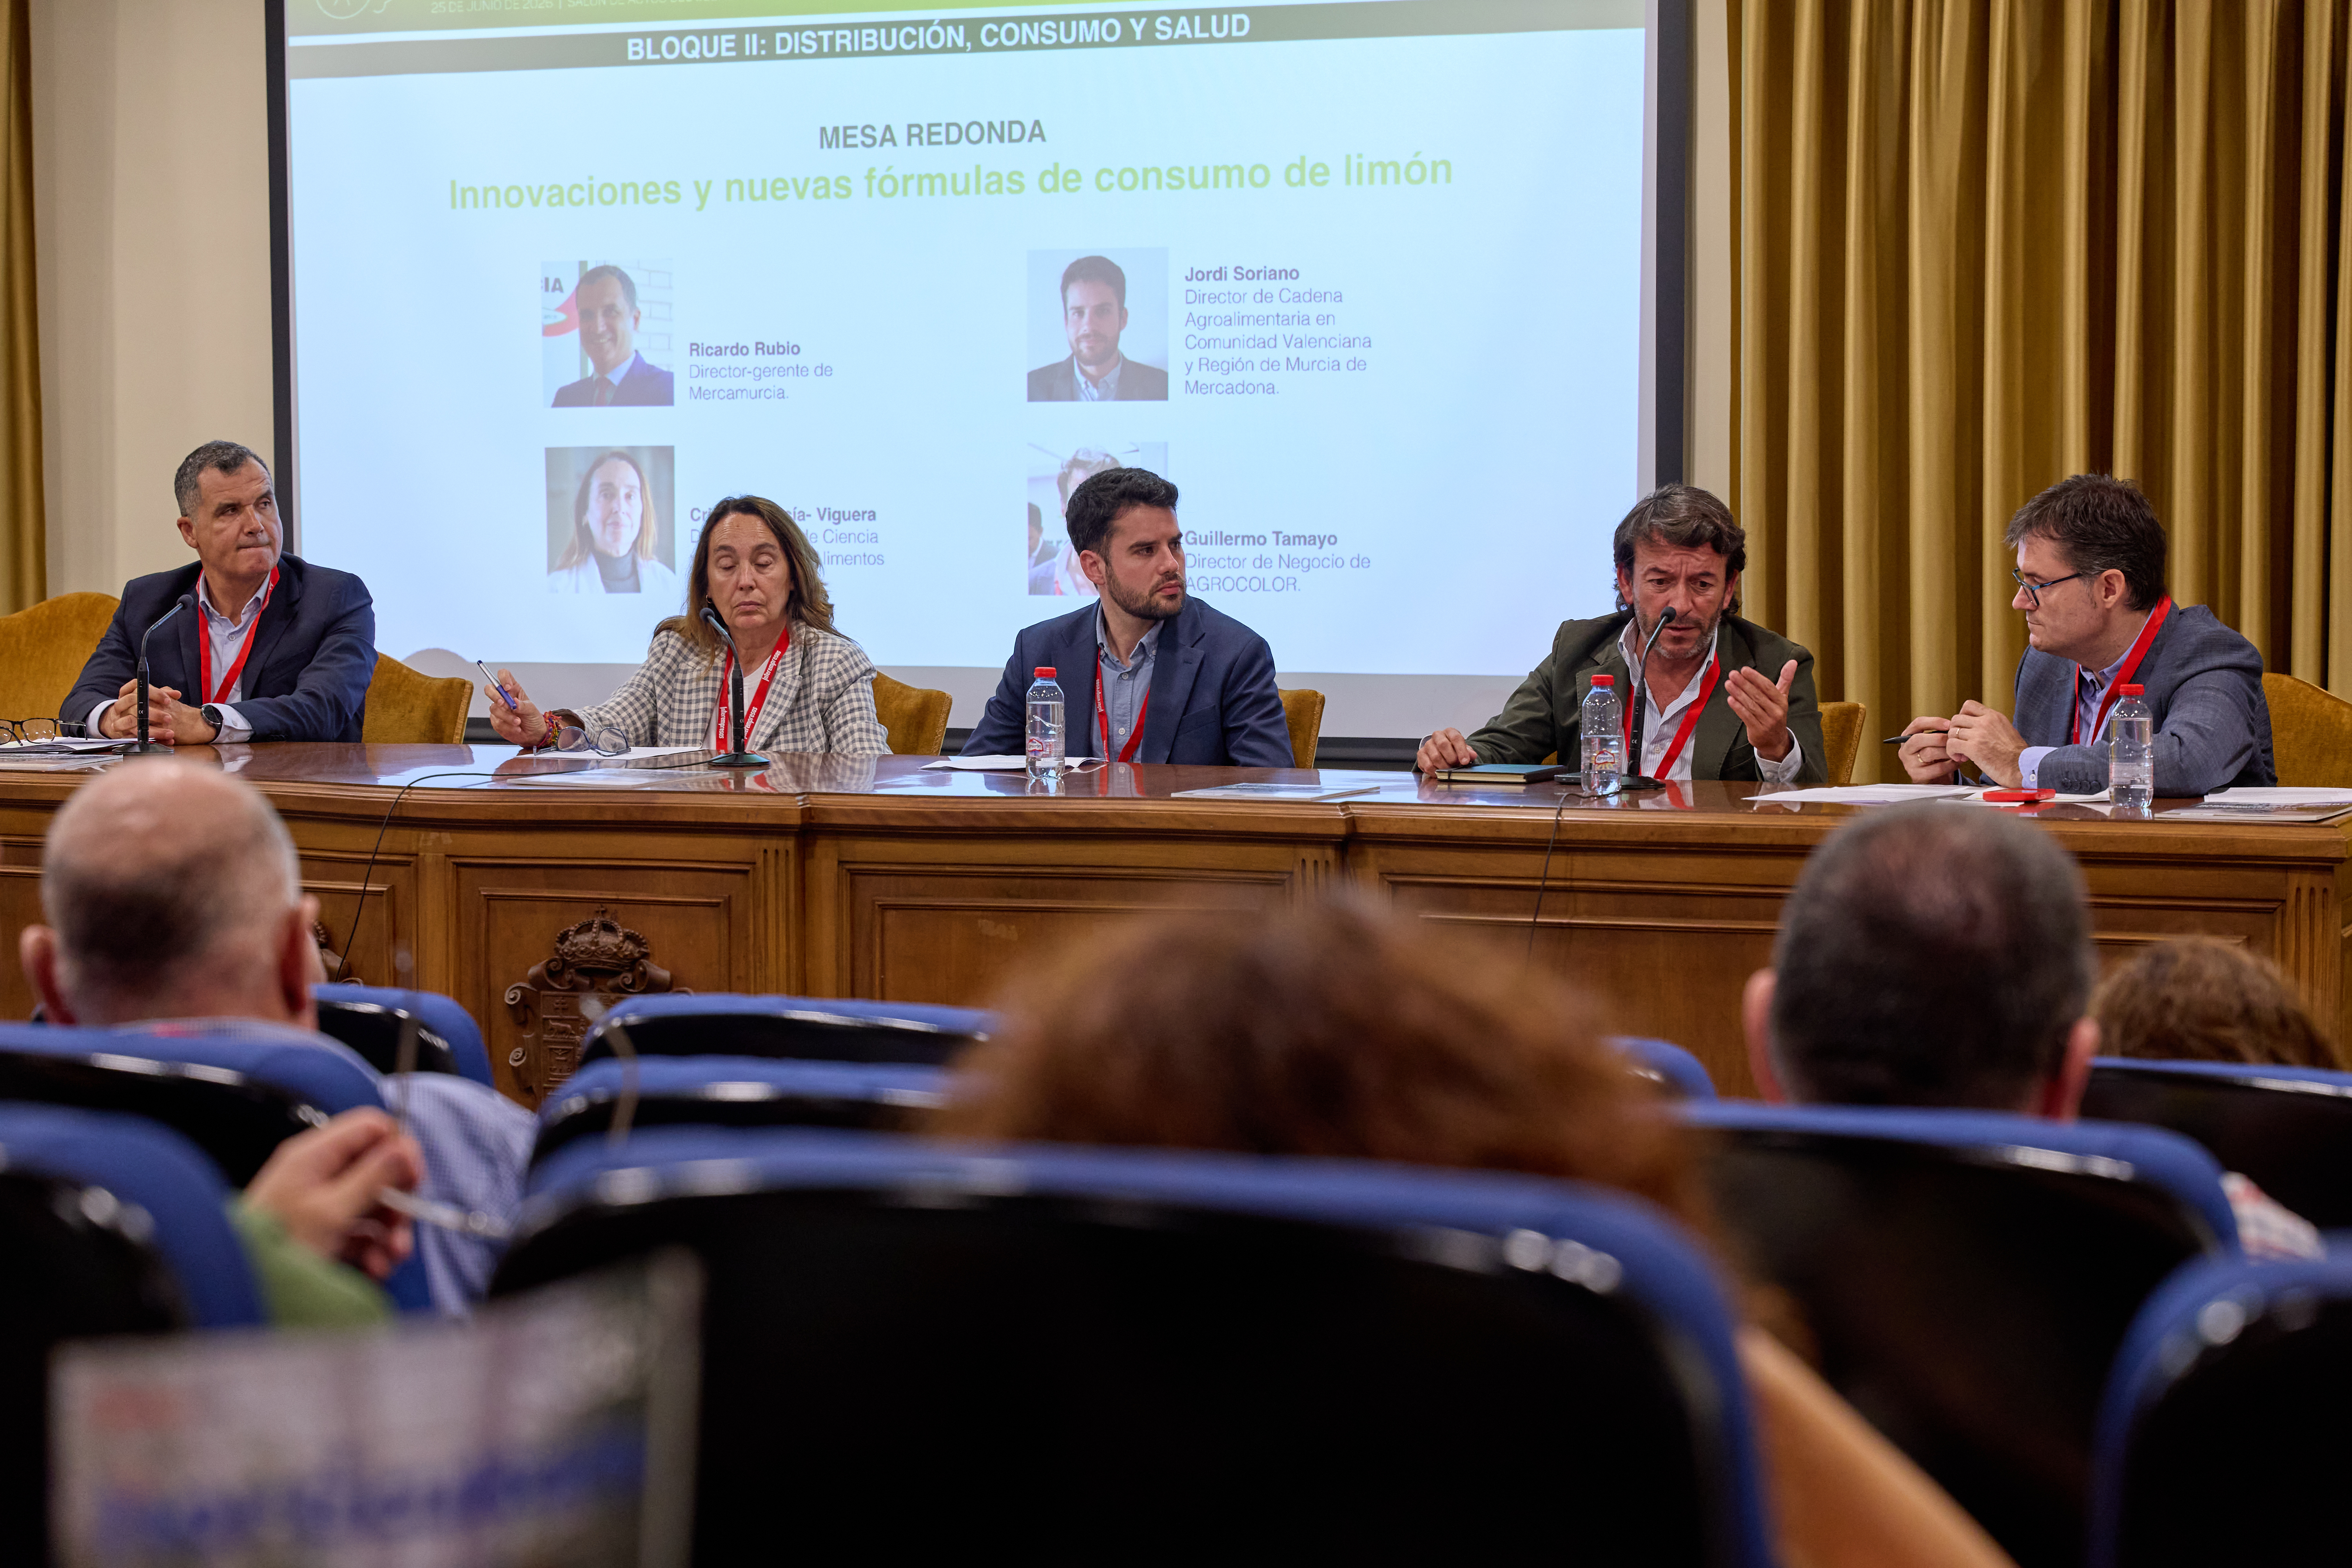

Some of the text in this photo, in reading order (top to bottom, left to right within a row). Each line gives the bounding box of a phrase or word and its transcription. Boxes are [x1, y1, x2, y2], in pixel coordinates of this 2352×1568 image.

[430, 2, 446, 13] 25
[448, 1, 464, 12] DE
[466, 0, 502, 11] JUNIO
[505, 0, 520, 10] DE
[523, 0, 554, 9] 2026
[627, 14, 1250, 60] BLOQUE II: DISTRIBUCIÓN, CONSUMO Y SALUD
[820, 120, 1047, 149] MESA REDONDA
[451, 151, 1451, 211] Innovaciones y nuevas fórmulas de consumo de limón
[1185, 266, 1299, 281] Jordi Soriano
[541, 277, 564, 293] IA
[1186, 288, 1343, 304] Director de Cadena
[1185, 311, 1335, 330] Agroalimentaria en
[690, 341, 800, 356] Ricardo Rubio
[1185, 334, 1372, 350] Comunidad Valenciana
[690, 363, 833, 381] Director-gerente de
[1185, 357, 1367, 376] y Región de Murcia de
[690, 386, 789, 400] Mercamurcia.
[1185, 380, 1279, 395] Mercadona.
[817, 508, 876, 525] Viguera
[823, 529, 878, 543] Ciencia
[1185, 530, 1337, 549] Guillermo Tamayo
[823, 551, 885, 566] limentos
[1186, 554, 1370, 572] Director de Negocio de
[1187, 577, 1300, 592] AGROCOLOR.
[762, 650, 781, 682] Interempresas
[719, 707, 727, 739] Interempresas
